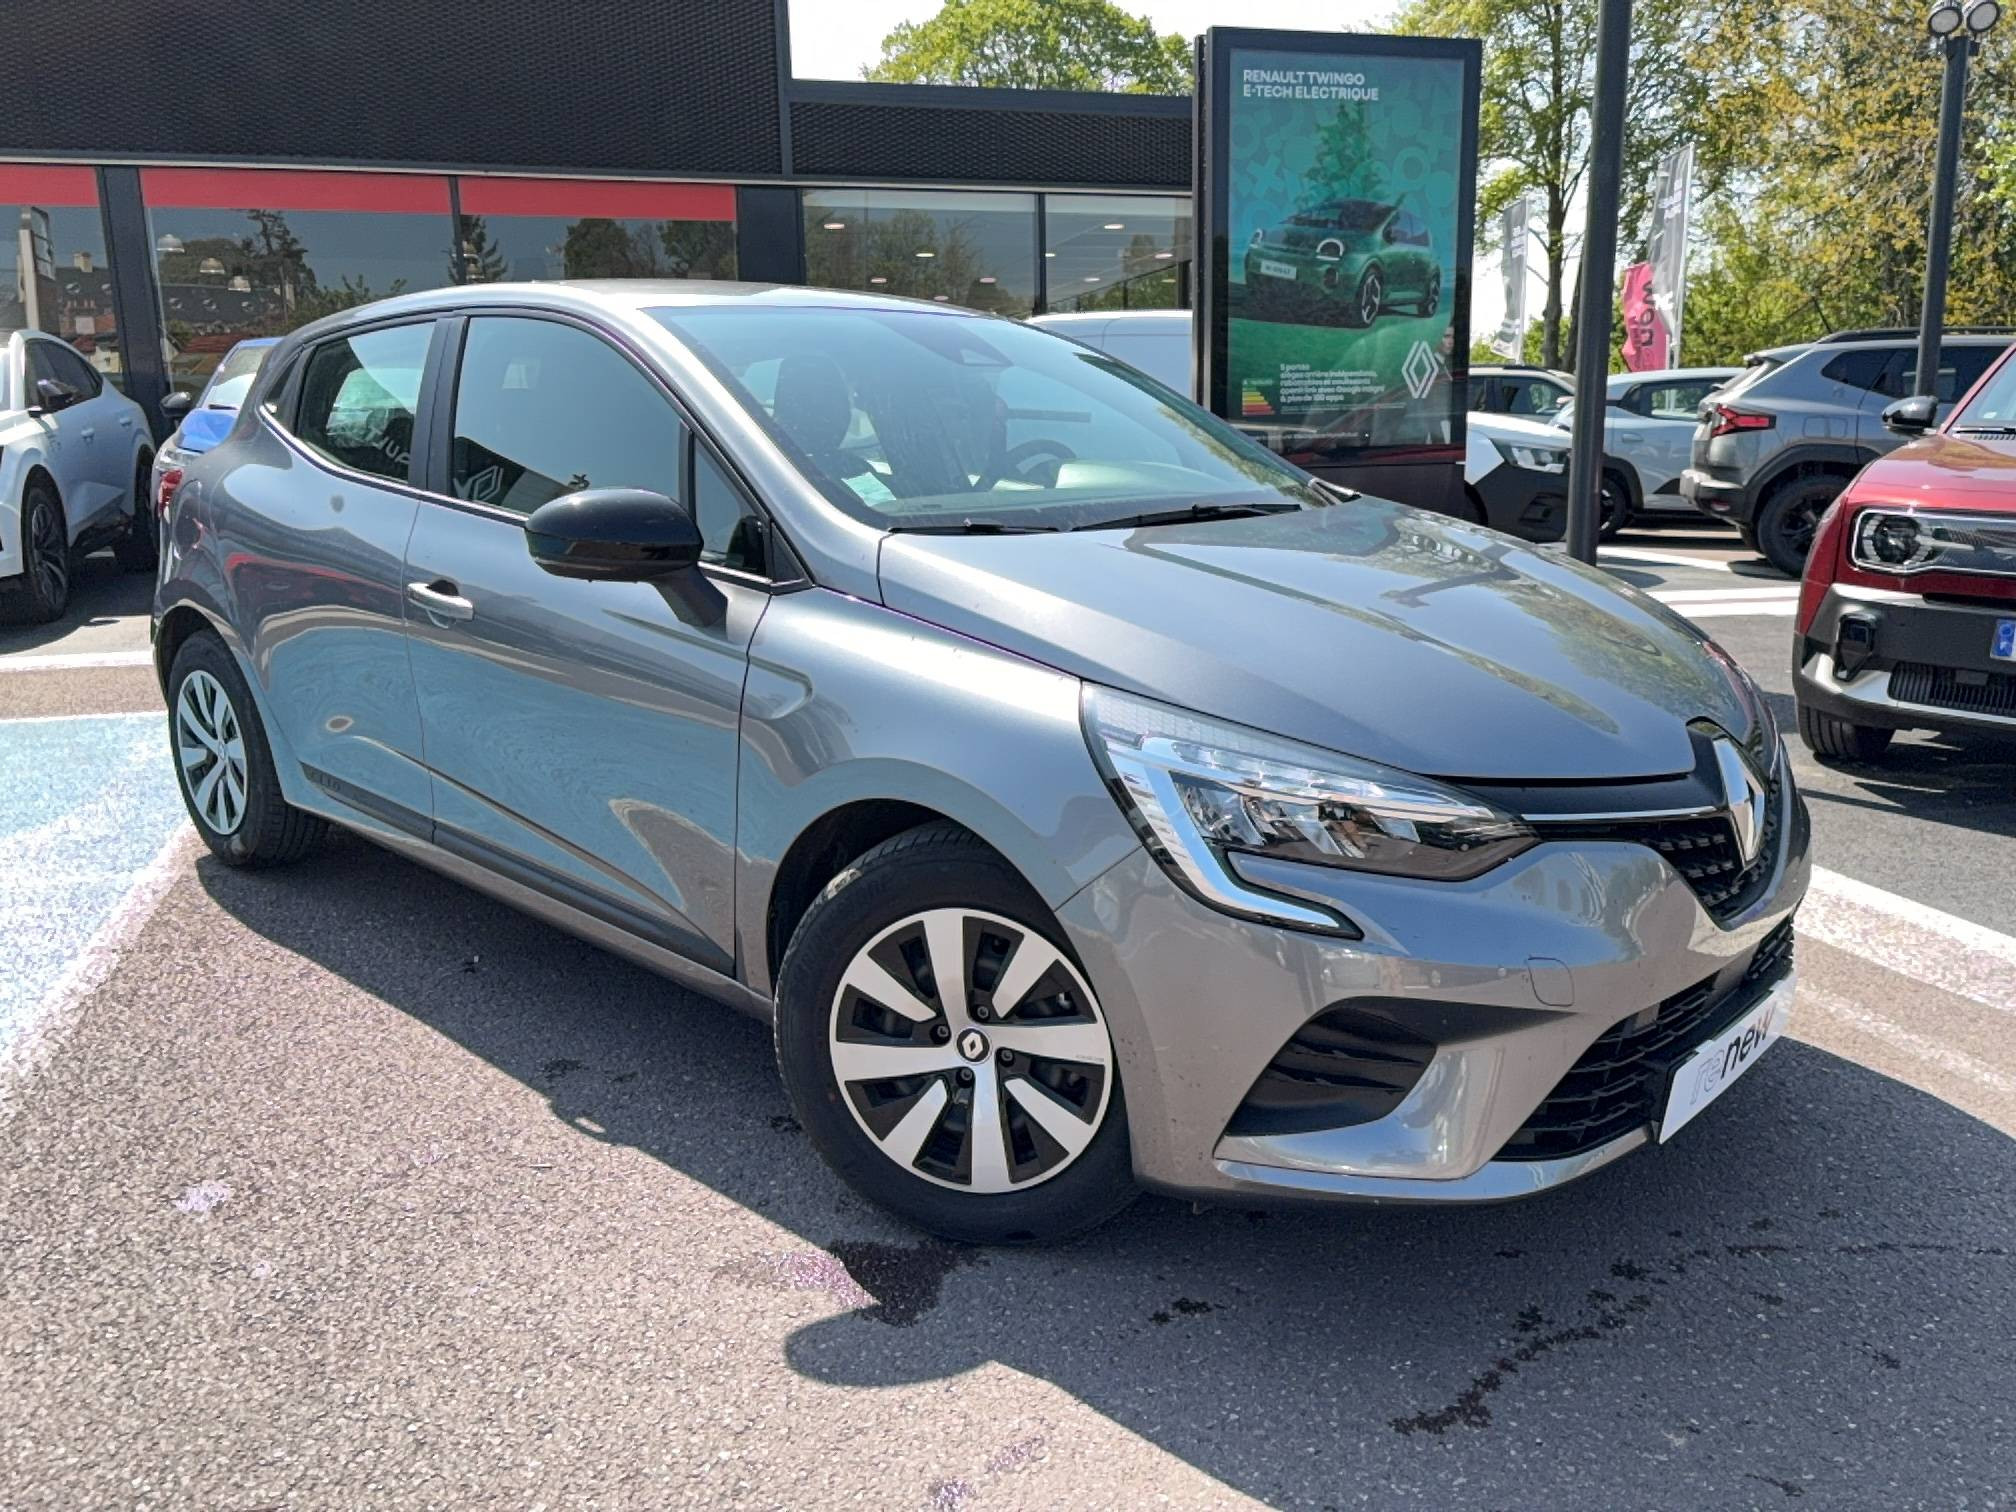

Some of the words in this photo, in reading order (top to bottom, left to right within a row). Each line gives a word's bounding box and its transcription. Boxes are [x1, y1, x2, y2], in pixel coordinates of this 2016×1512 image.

[1243, 70, 1305, 84] RENAULT
[1306, 71, 1365, 85] TWINGO
[1243, 84, 1293, 98] E-TECH
[1295, 85, 1379, 101] ELECTRIQUE
